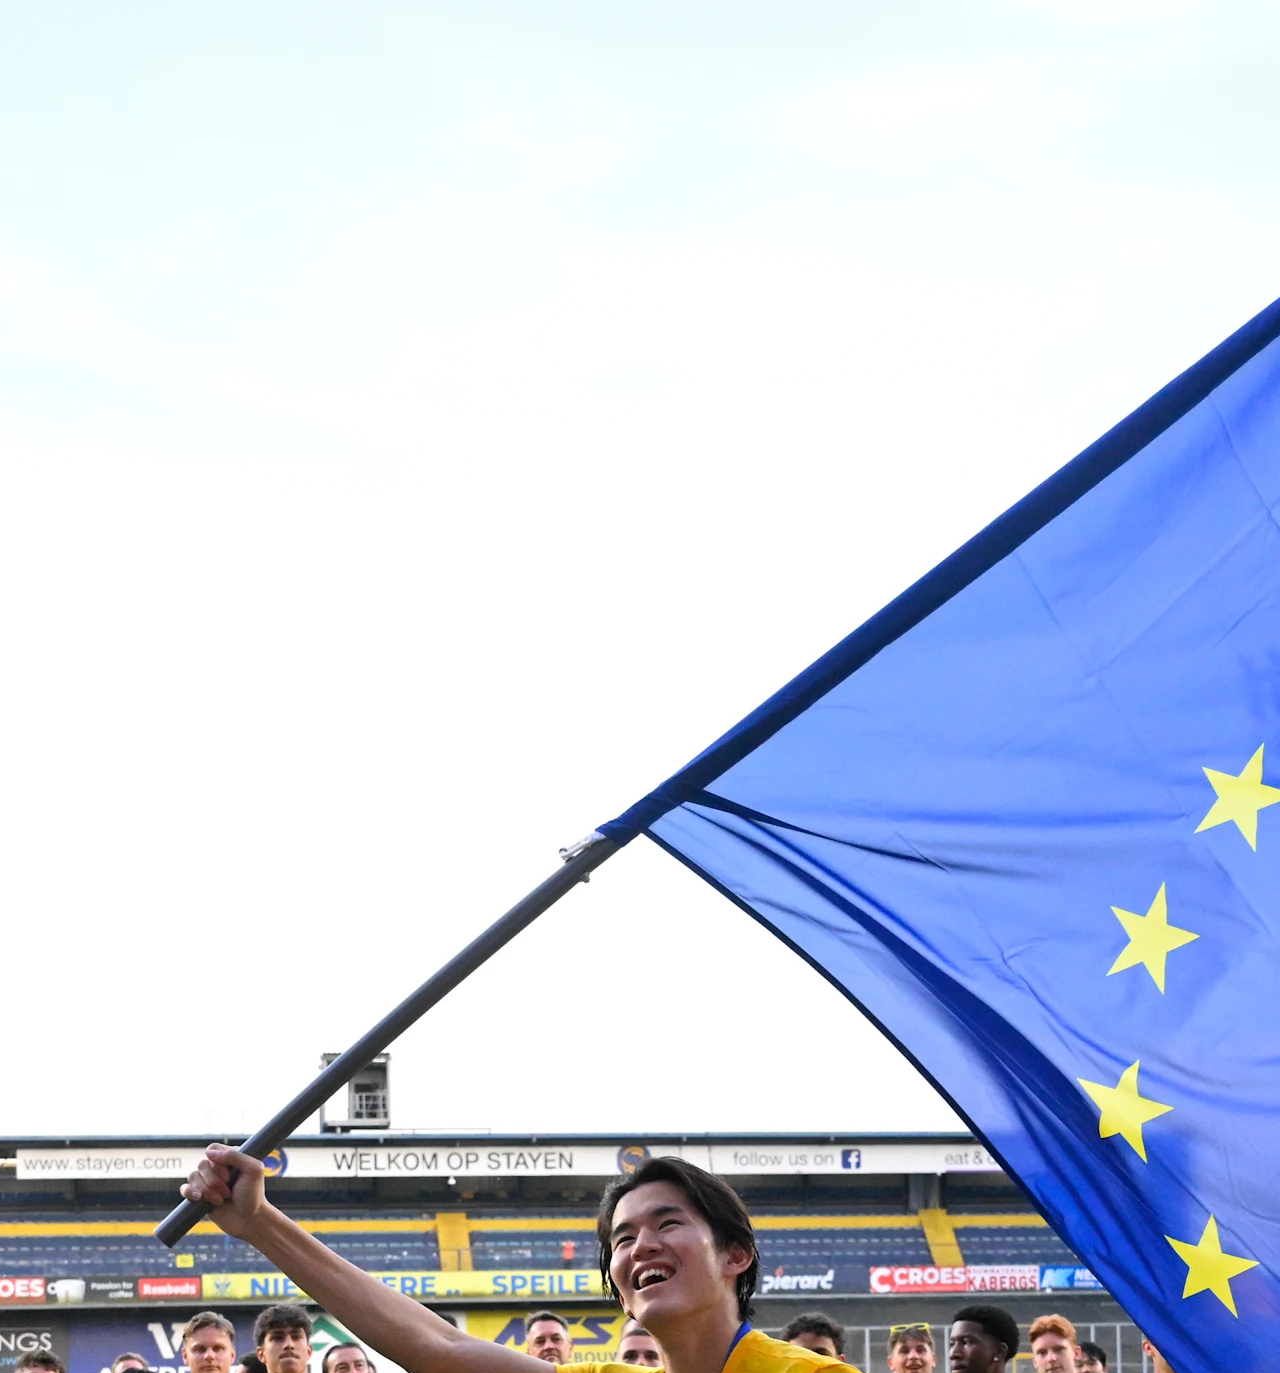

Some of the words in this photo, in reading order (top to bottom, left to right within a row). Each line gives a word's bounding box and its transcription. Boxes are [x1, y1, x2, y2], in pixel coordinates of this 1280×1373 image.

[23, 1154, 182, 1173] www.stayen.com
[334, 1152, 439, 1171] WELKOM
[446, 1152, 479, 1170] OP
[486, 1151, 574, 1171] STAYEN
[734, 1151, 783, 1167] follow
[788, 1154, 808, 1166] us
[813, 1154, 835, 1166] on
[944, 1153, 969, 1166] eat
[972, 1152, 984, 1165] &
[762, 1266, 835, 1291] pierard
[893, 1267, 967, 1285] CROES
[967, 1275, 1038, 1291] KABERGS
[491, 1274, 591, 1297] SPEILE
